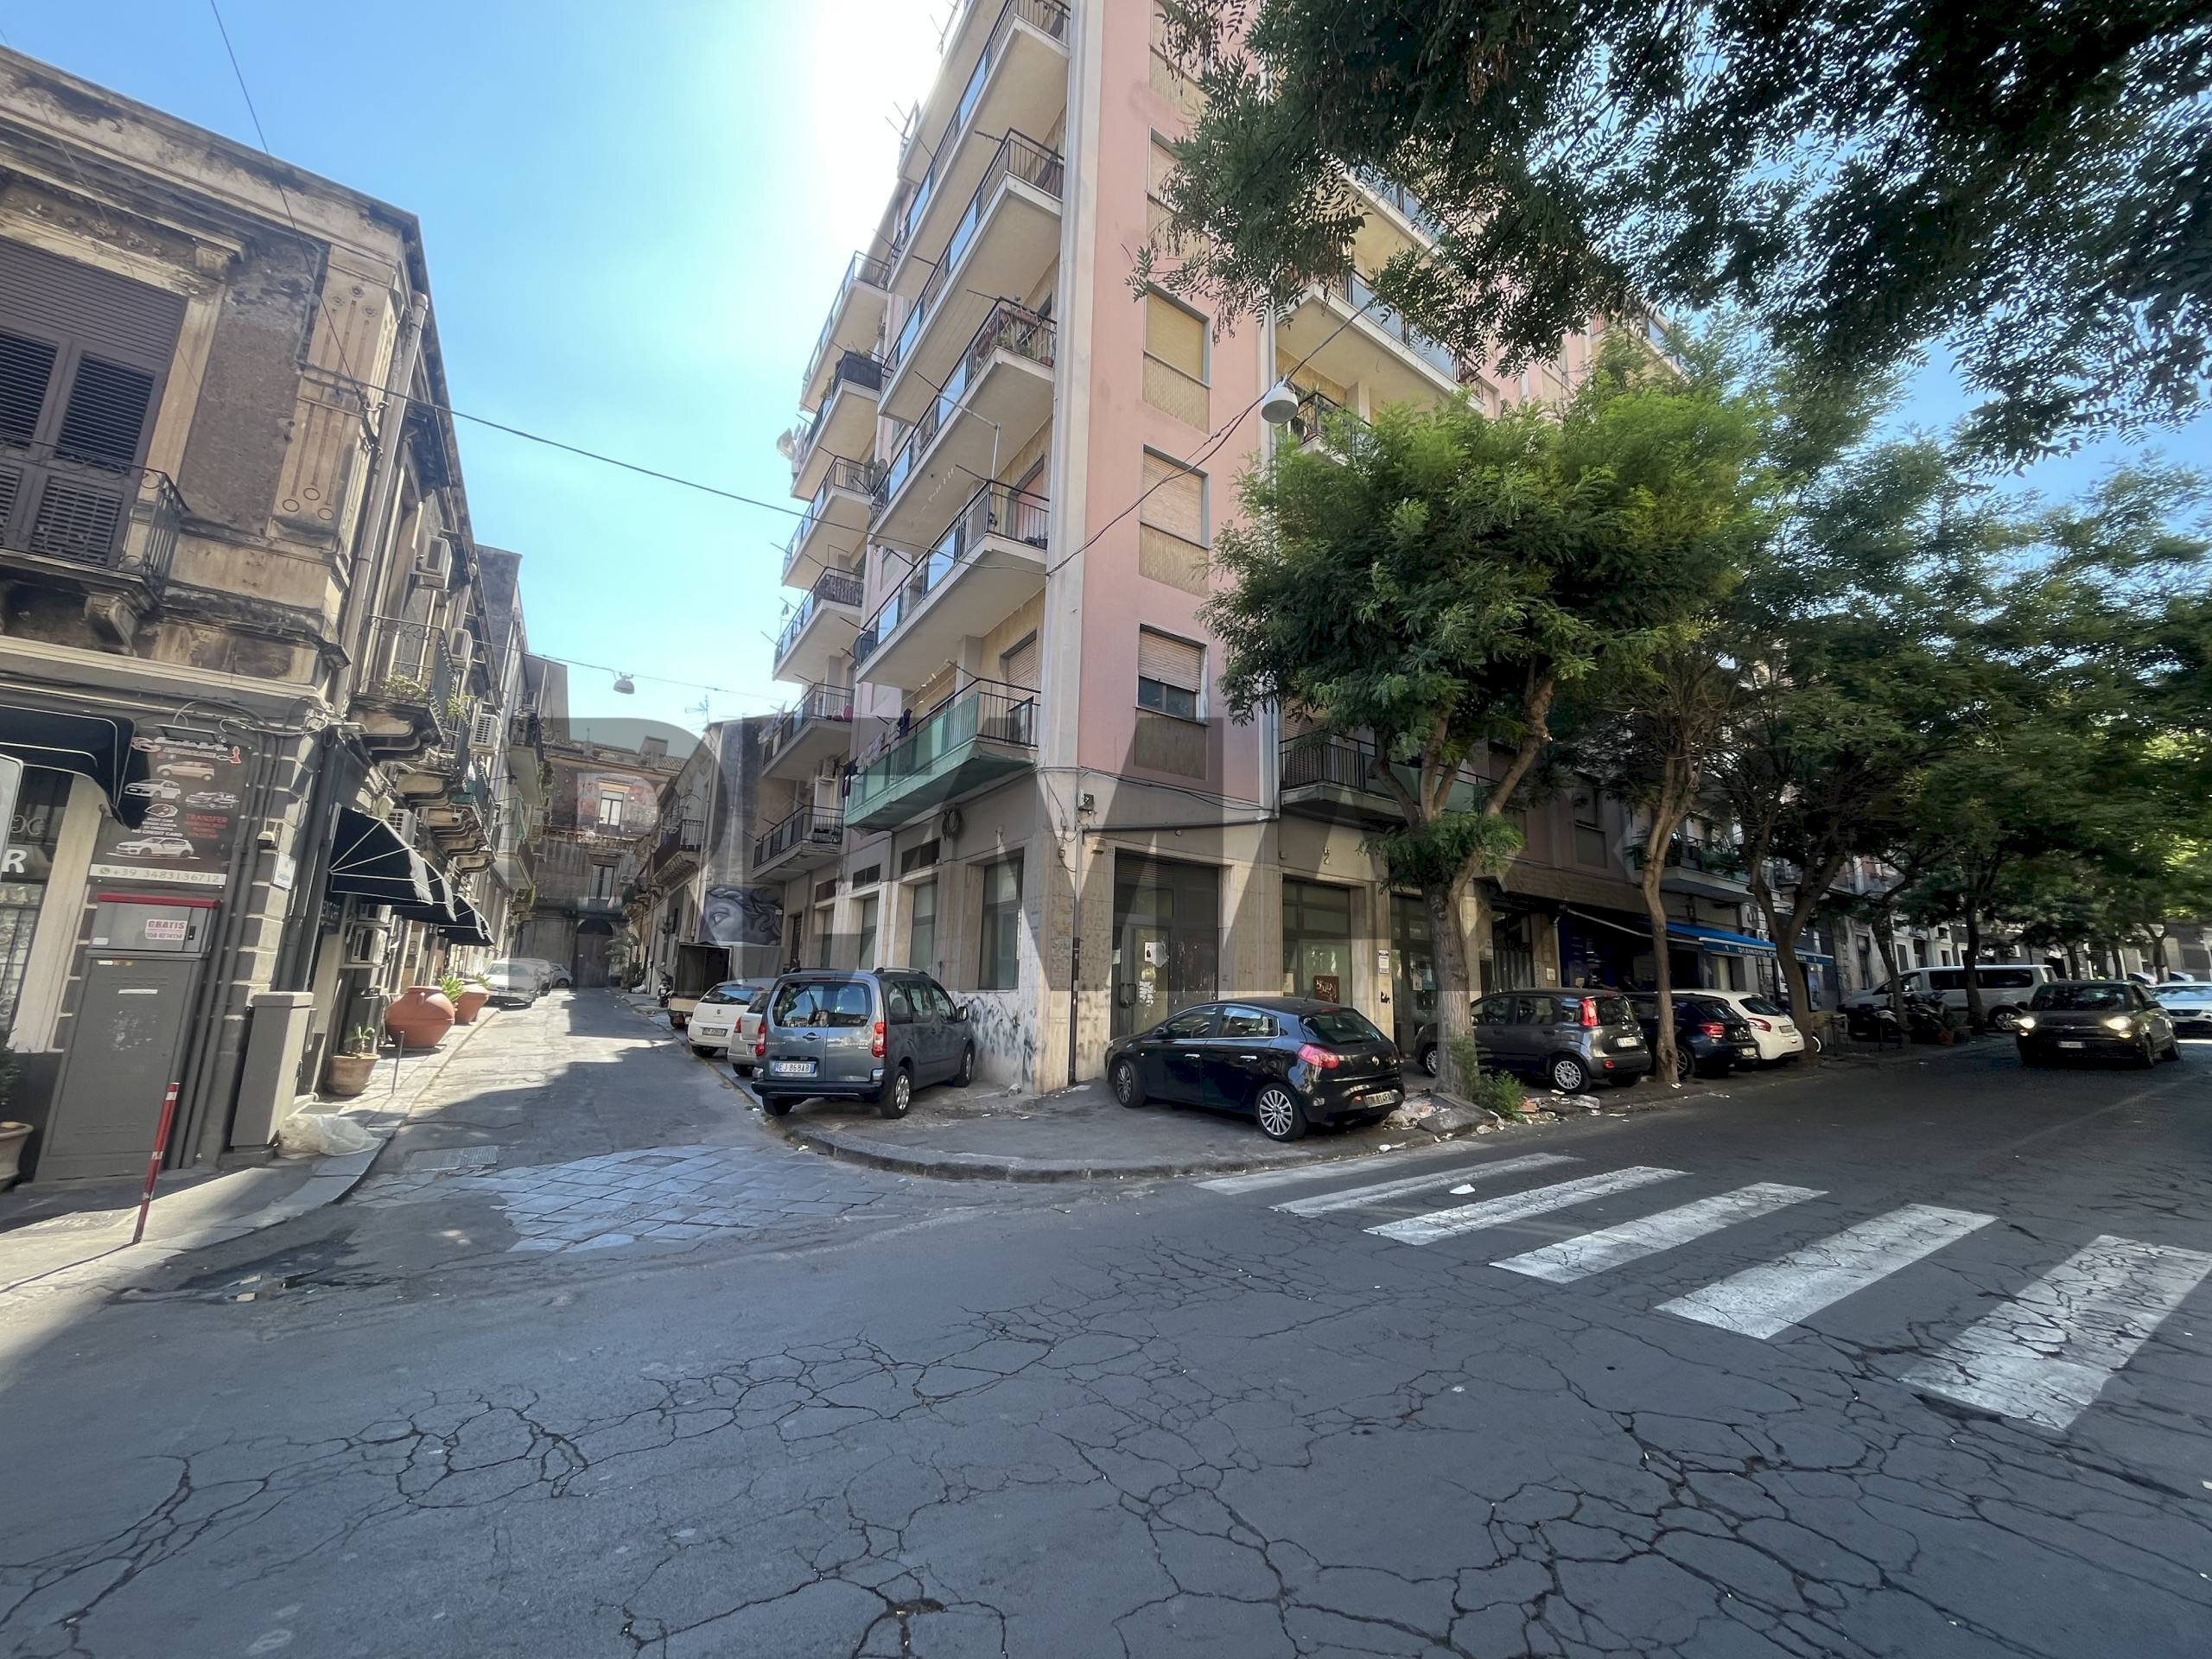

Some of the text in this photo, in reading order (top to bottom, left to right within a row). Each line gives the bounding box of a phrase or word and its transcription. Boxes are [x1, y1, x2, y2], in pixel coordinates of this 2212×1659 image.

[186, 813, 228, 823] TRANSFER
[113, 868, 219, 883] +39 3483136712
[148, 920, 185, 930] GRATIS
